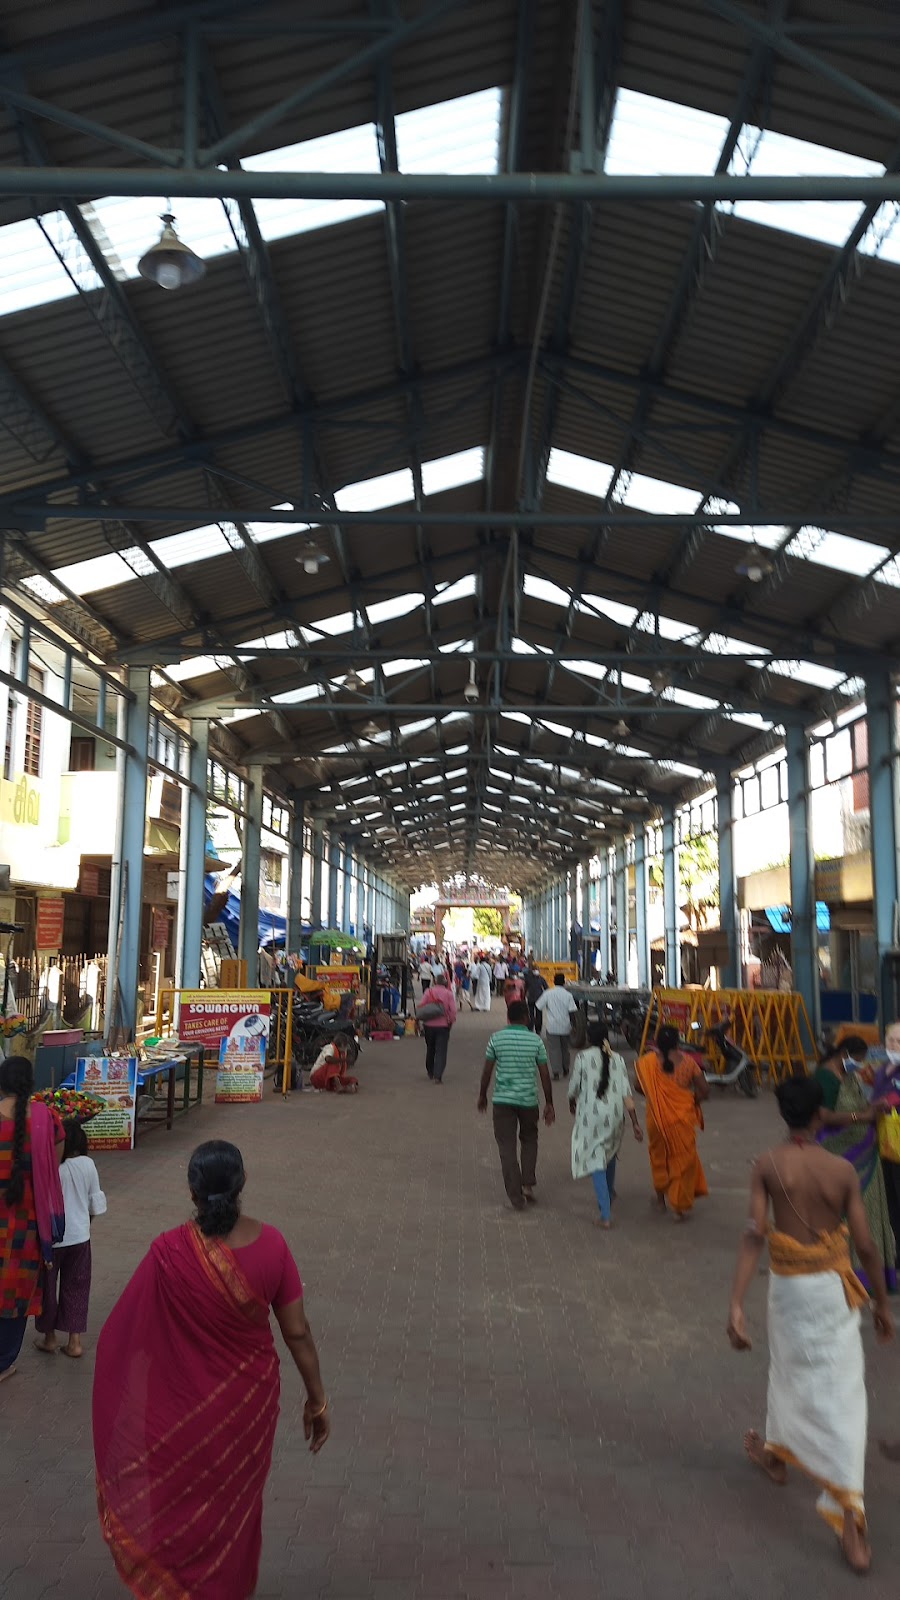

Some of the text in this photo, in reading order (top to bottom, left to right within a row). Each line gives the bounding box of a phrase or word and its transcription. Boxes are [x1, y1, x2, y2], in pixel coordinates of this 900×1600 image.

[189, 1004, 260, 1013] SOWBAGHYA
[184, 1017, 228, 1030] TAKES CARE OF
